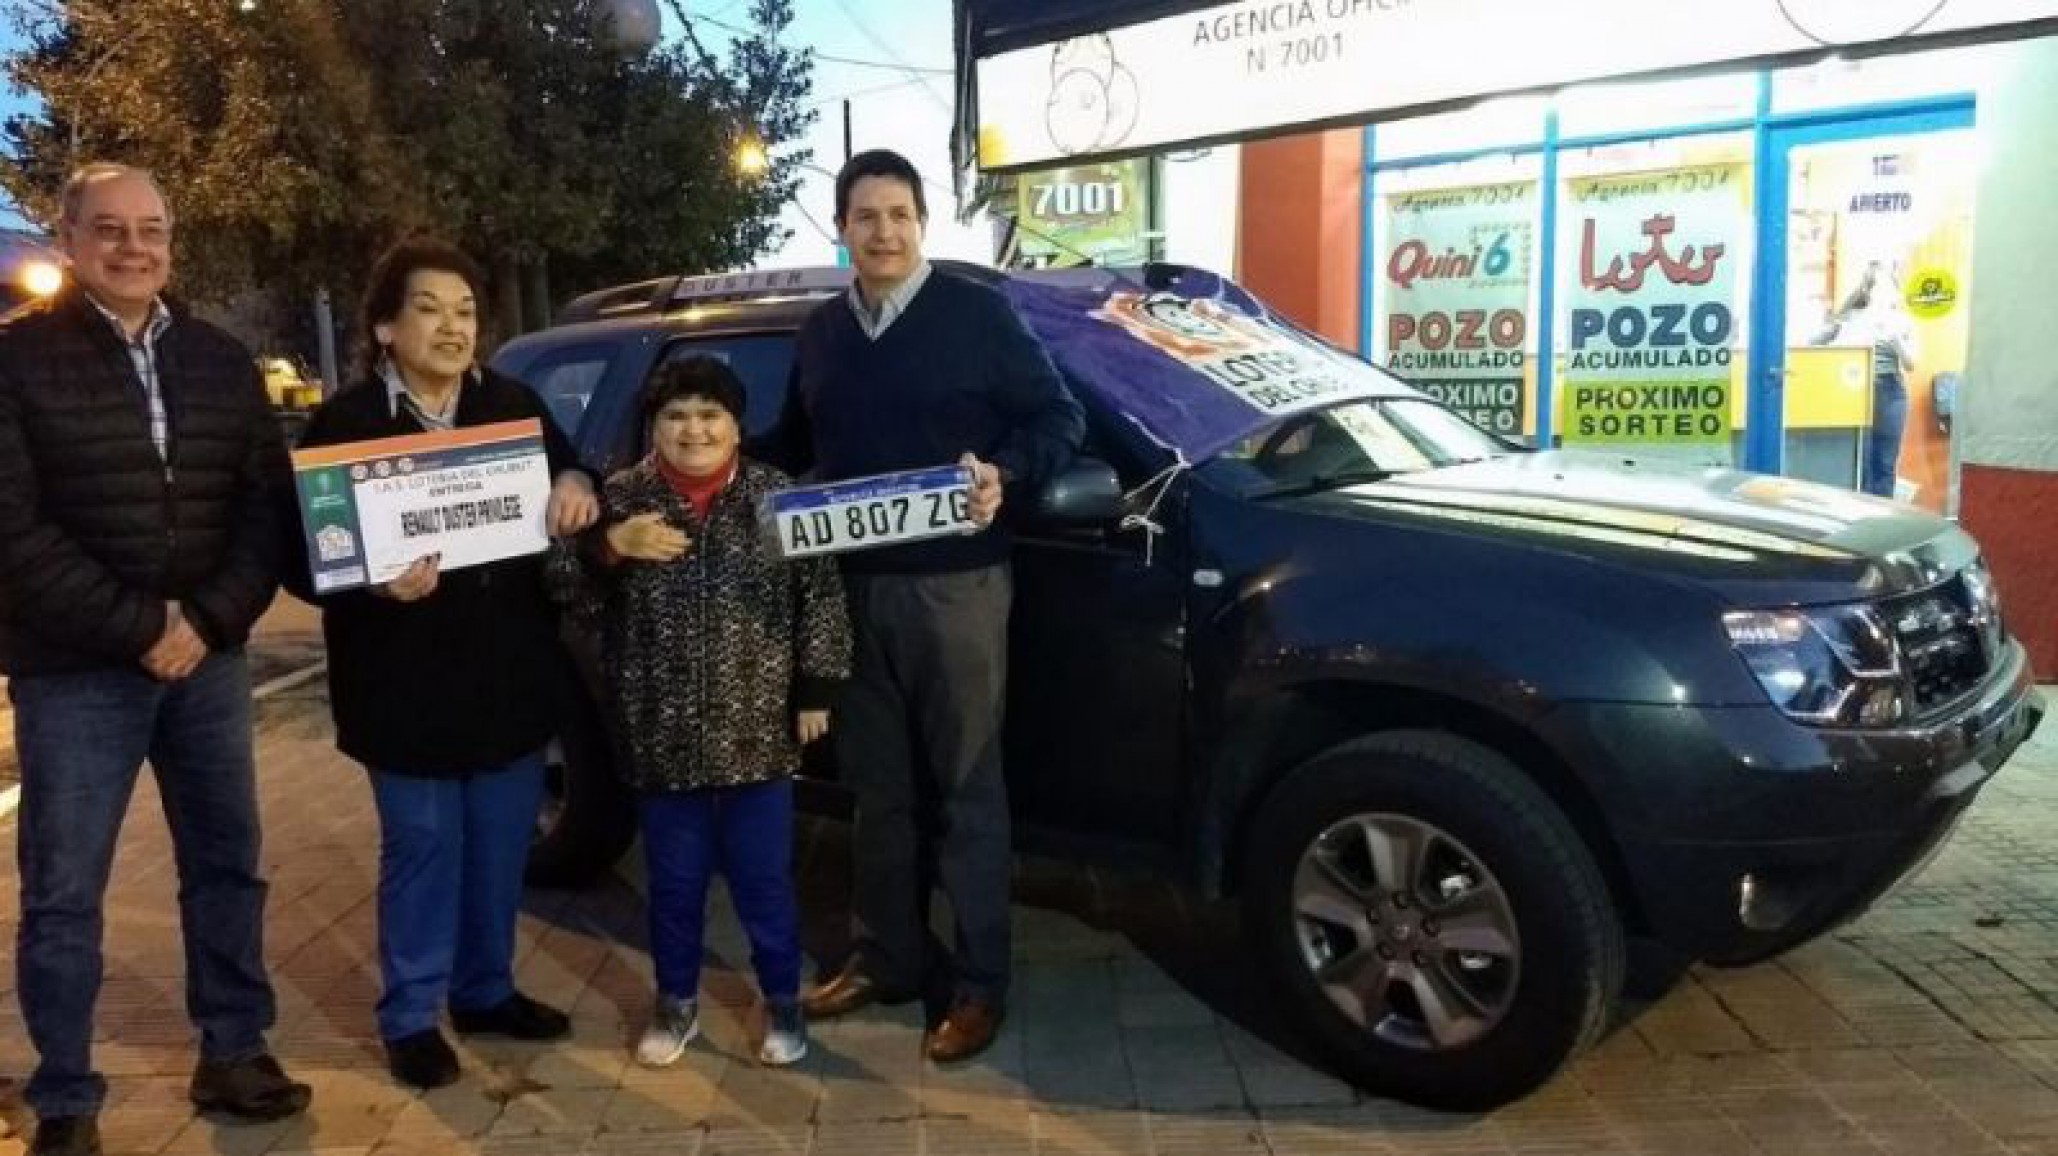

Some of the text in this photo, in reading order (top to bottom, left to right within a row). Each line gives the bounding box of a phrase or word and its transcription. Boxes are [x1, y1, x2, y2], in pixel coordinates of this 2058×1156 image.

[1194, 3, 1315, 46] AGENCIA
[1281, 32, 1344, 67] 7001
[1031, 182, 1122, 215] 7001
[1387, 232, 1511, 290] Quini 6
[1388, 309, 1526, 350] POZO
[1572, 301, 1732, 350] POZO
[1388, 351, 1524, 370] ACUMULADO
[1571, 348, 1731, 370] ACUMULADO
[1575, 384, 1725, 411] PROXIMO
[1579, 413, 1722, 437] SORTEO
[442, 501, 477, 532] DUSTER
[791, 510, 834, 549] AD
[845, 496, 909, 540] 807
